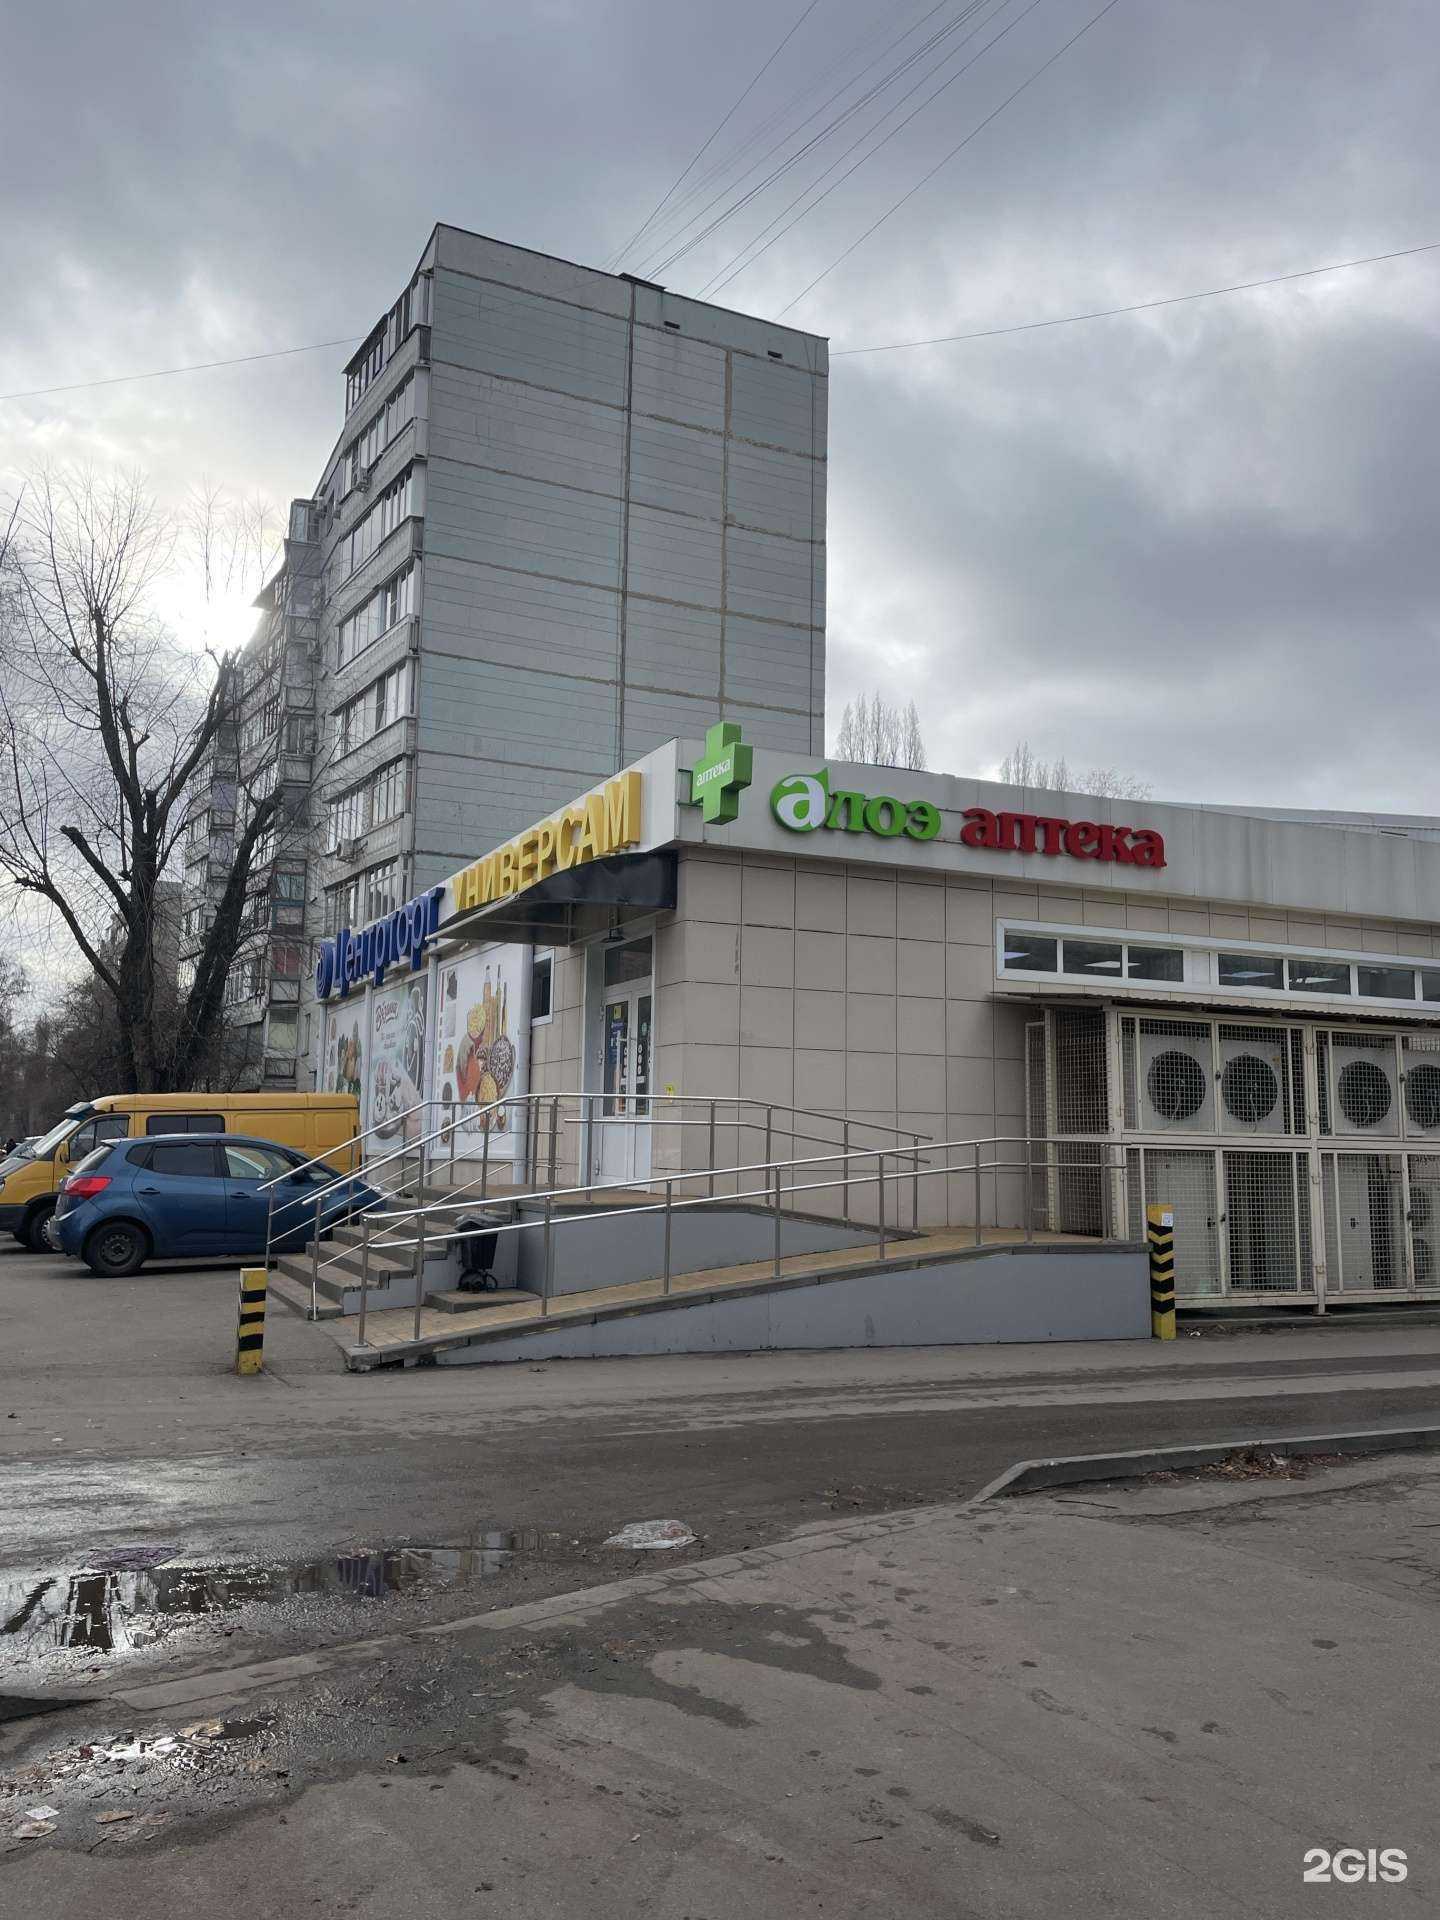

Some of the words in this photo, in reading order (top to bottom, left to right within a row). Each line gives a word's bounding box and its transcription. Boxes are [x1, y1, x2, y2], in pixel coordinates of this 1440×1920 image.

[696, 758, 731, 787] аптека
[771, 767, 941, 841] алоэ
[960, 807, 1167, 867] аптека
[332, 886, 446, 998] Центрторг
[452, 770, 642, 913] УНИВЕРСАМ
